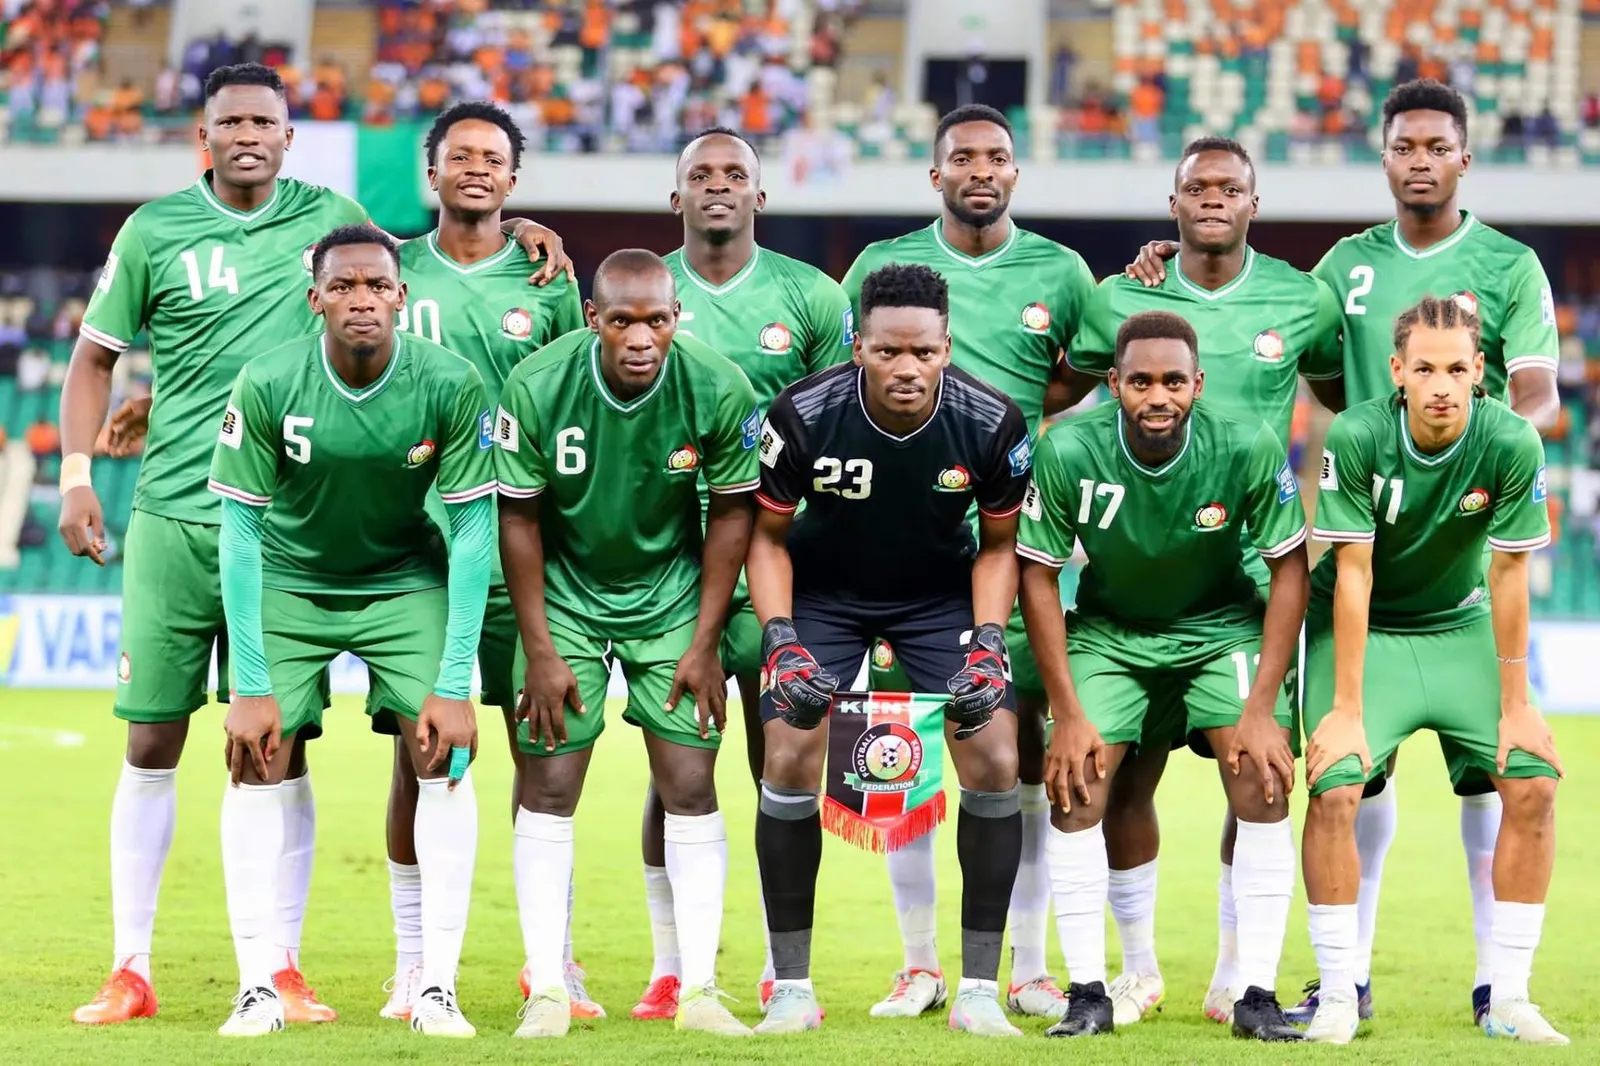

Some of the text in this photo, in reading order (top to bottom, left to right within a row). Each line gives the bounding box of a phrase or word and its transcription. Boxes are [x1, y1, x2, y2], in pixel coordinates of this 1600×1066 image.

[180, 246, 239, 301] 14
[1345, 265, 1375, 315] 2
[283, 414, 314, 464] 5
[556, 426, 586, 475] 6
[813, 456, 874, 500] 23
[1372, 473, 1404, 525] 11
[1078, 478, 1126, 530] 17
[1231, 651, 1260, 700] 1
[856, 733, 877, 778] FOOTBALL
[860, 780, 915, 791] FEDERATION
